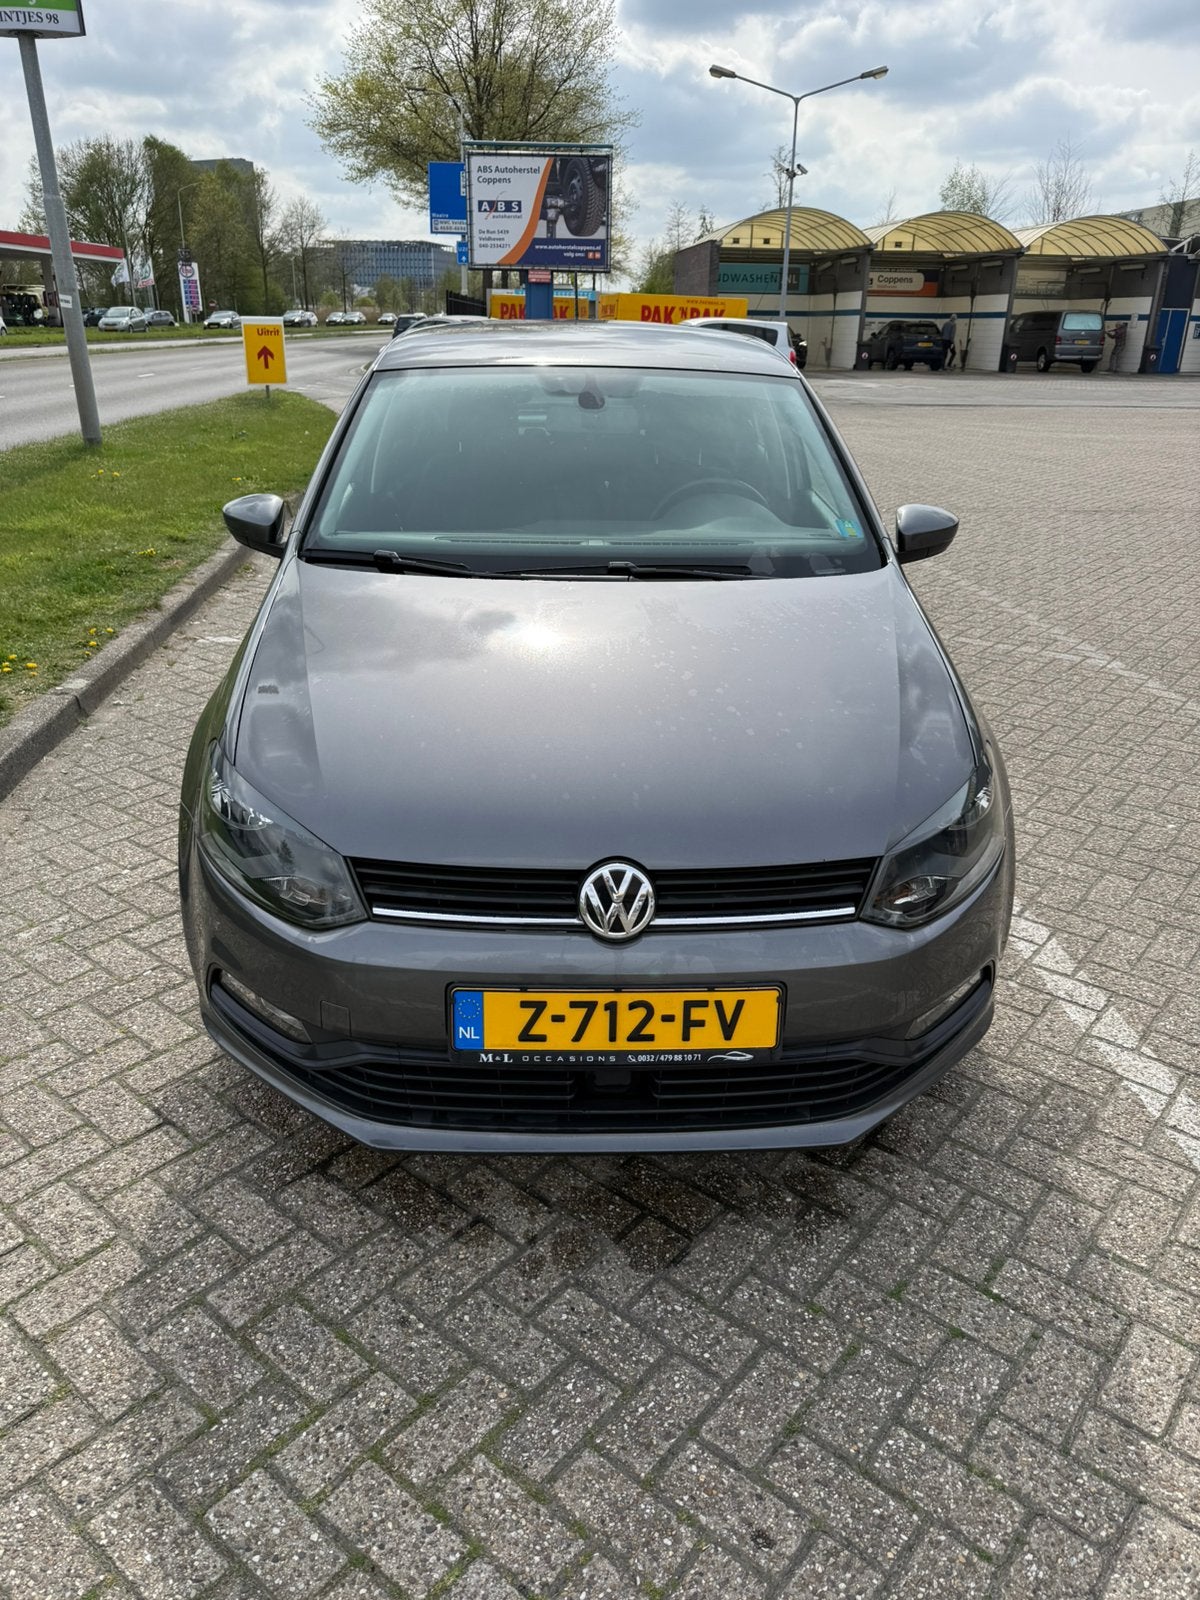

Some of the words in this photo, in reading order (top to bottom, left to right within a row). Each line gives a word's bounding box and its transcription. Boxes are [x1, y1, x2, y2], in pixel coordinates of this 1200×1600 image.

[45, 13, 60, 24] 98
[477, 165, 493, 173] ABS
[494, 165, 541, 174] Autoherstel
[477, 176, 511, 185] Coppens
[481, 201, 519, 211] ABS
[877, 274, 913, 284] Coppens
[641, 304, 676, 324] PAK
[256, 327, 280, 336] Uitrit
[518, 999, 745, 1042] Z-712-FV
[458, 1026, 480, 1039] NL
[637, 1054, 655, 1062] 0032
[660, 1054, 673, 1062] 479
[673, 1054, 683, 1062] 88
[693, 1053, 702, 1061] 71
